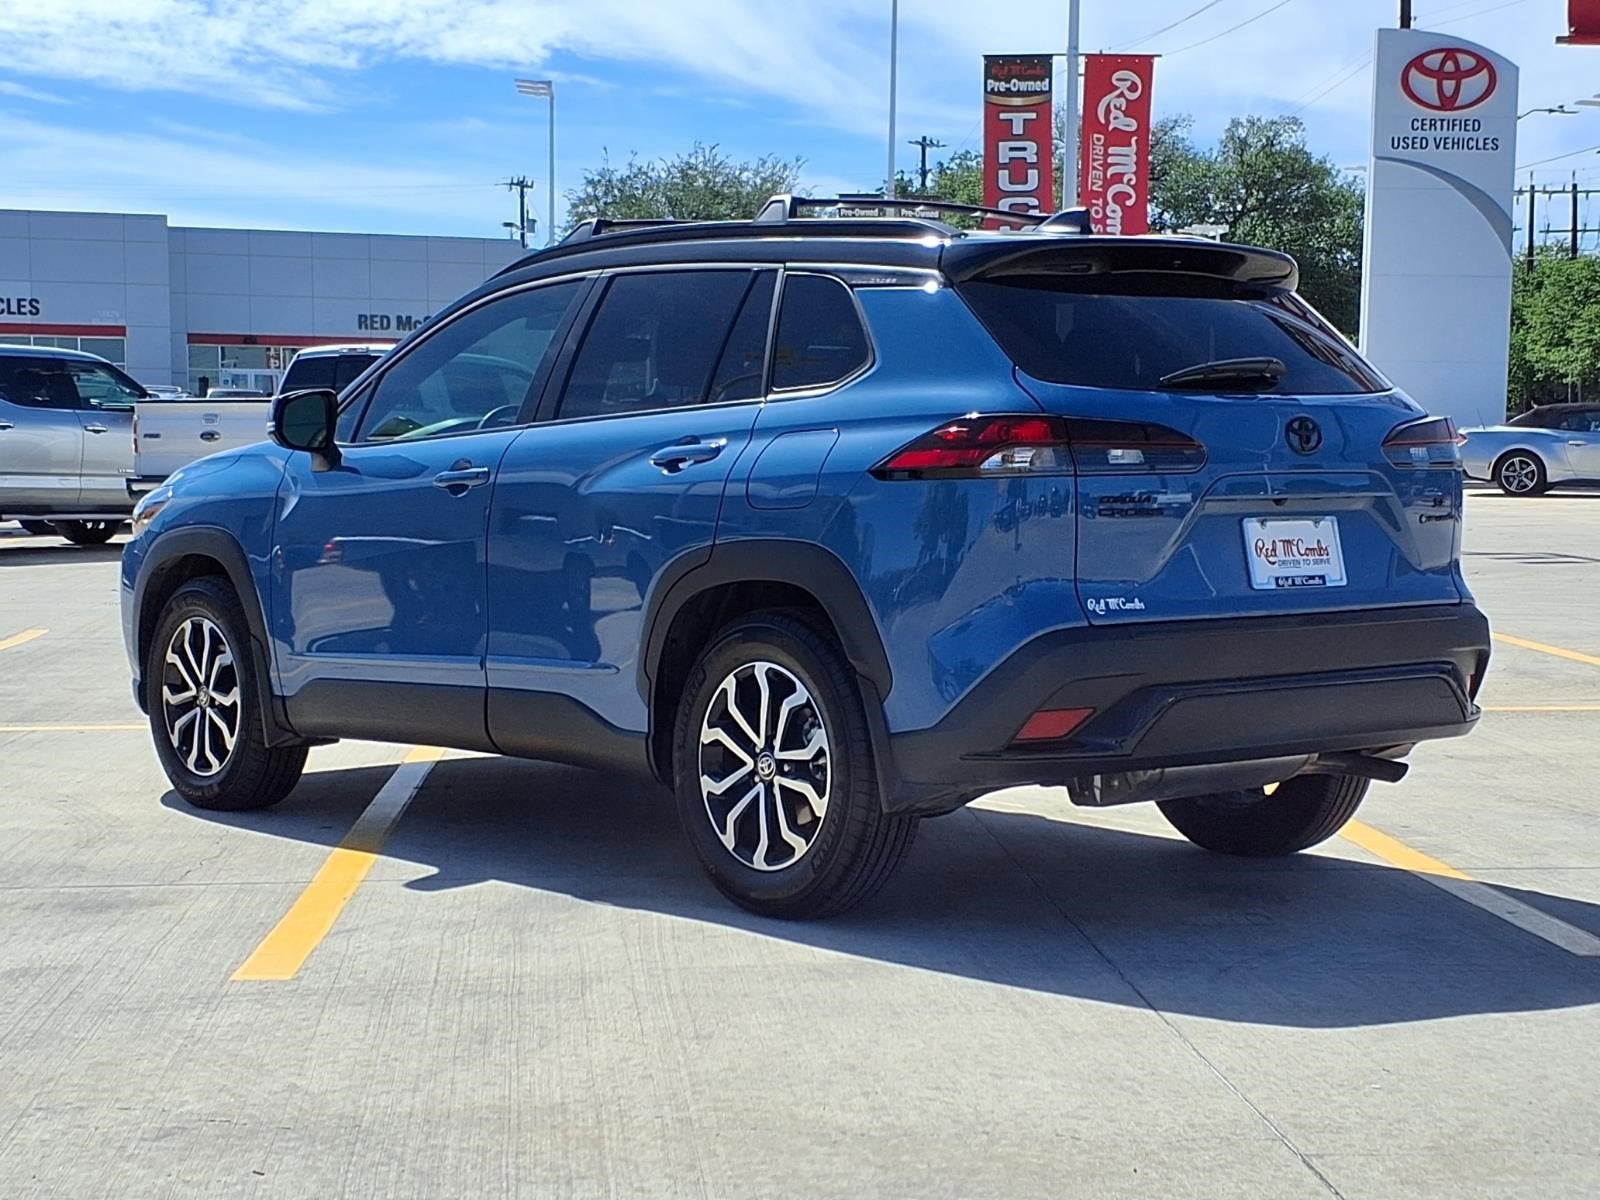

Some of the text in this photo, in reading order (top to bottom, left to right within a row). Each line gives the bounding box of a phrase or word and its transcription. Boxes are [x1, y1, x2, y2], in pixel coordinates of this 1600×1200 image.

[987, 78, 1050, 92] Pre-Owned
[1097, 70, 1142, 132] Red
[1411, 118, 1481, 132] CERTIFIED
[1391, 136, 1499, 151] USED VEHICLES
[1092, 133, 1104, 192] DRIVEN
[998, 112, 1039, 233] TRUC
[1091, 198, 1103, 218] TO
[358, 314, 391, 331] RED
[1255, 538, 1329, 565] Red McCombs
[1087, 598, 1105, 614] Red
